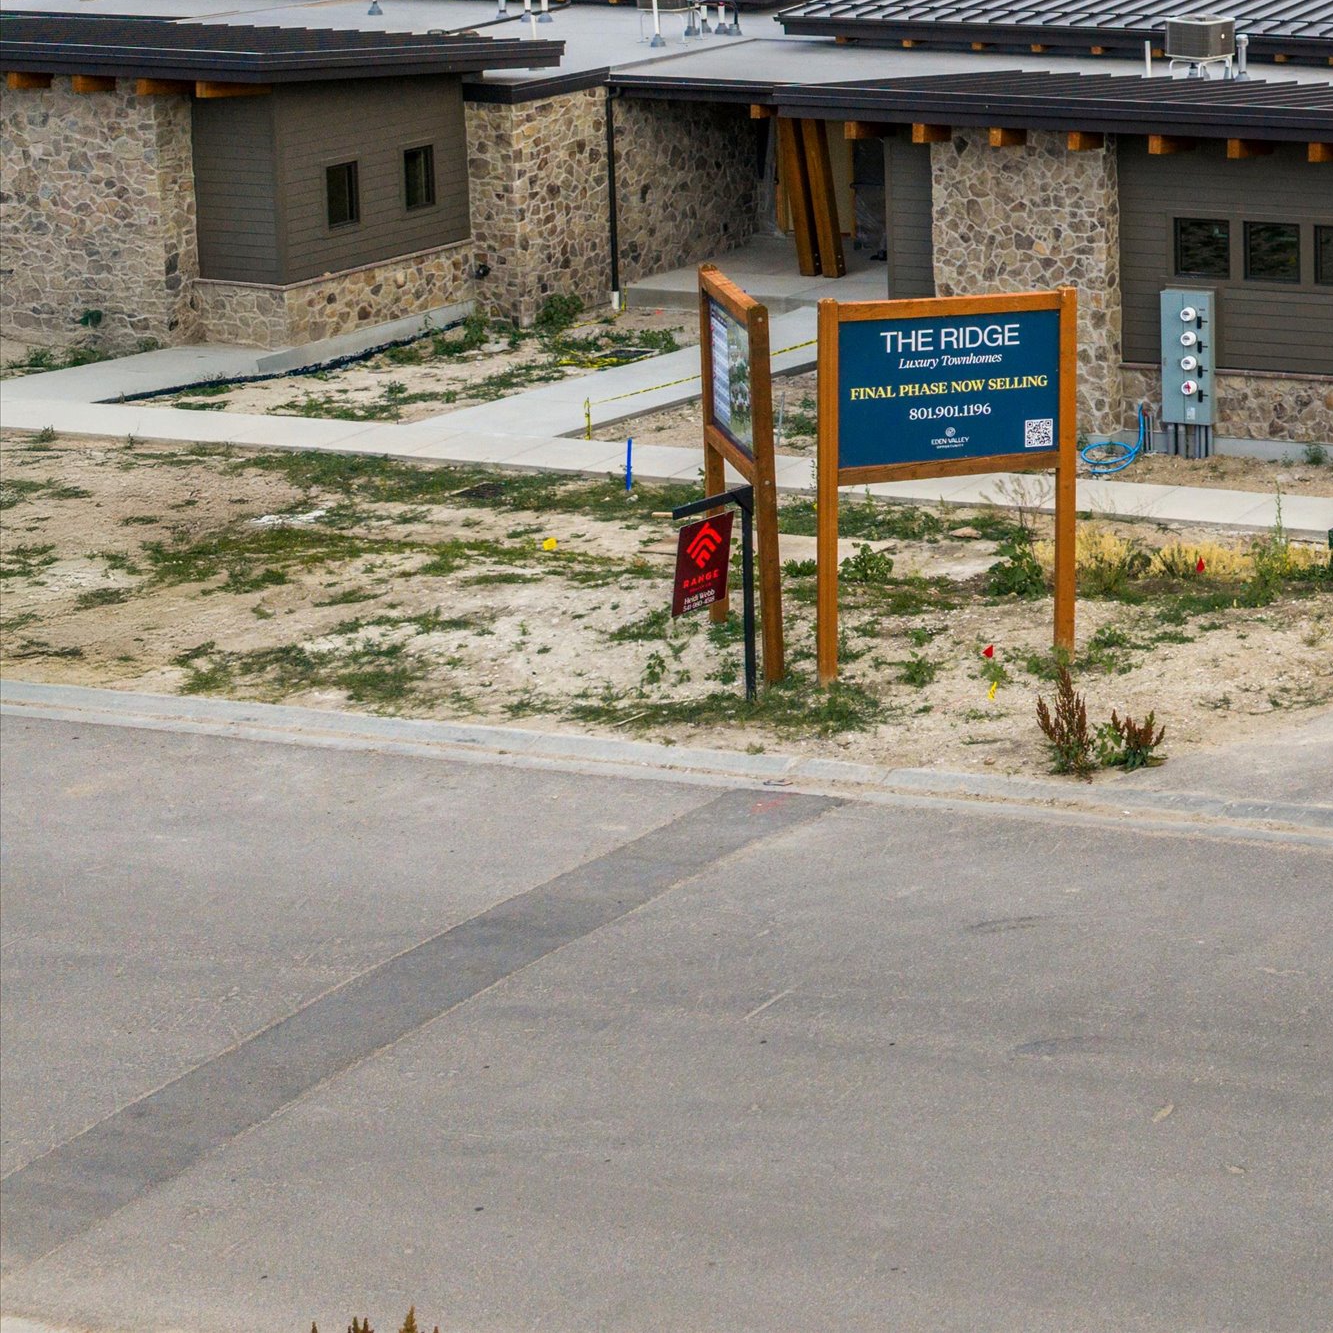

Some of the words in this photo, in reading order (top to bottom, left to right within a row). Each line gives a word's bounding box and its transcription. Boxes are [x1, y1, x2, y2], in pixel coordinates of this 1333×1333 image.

[880, 328, 934, 353] THE
[940, 323, 1021, 350] RIDGE
[898, 357, 939, 370] Luxury
[941, 352, 1002, 367] Townhomes
[850, 385, 896, 401] FINAL
[899, 381, 948, 397] PHASE
[951, 379, 986, 394] NOW
[988, 374, 1048, 390] SELLING
[909, 402, 992, 420] 801.901.1196
[948, 436, 970, 444] VALLEY
[683, 569, 719, 589] RANGE
